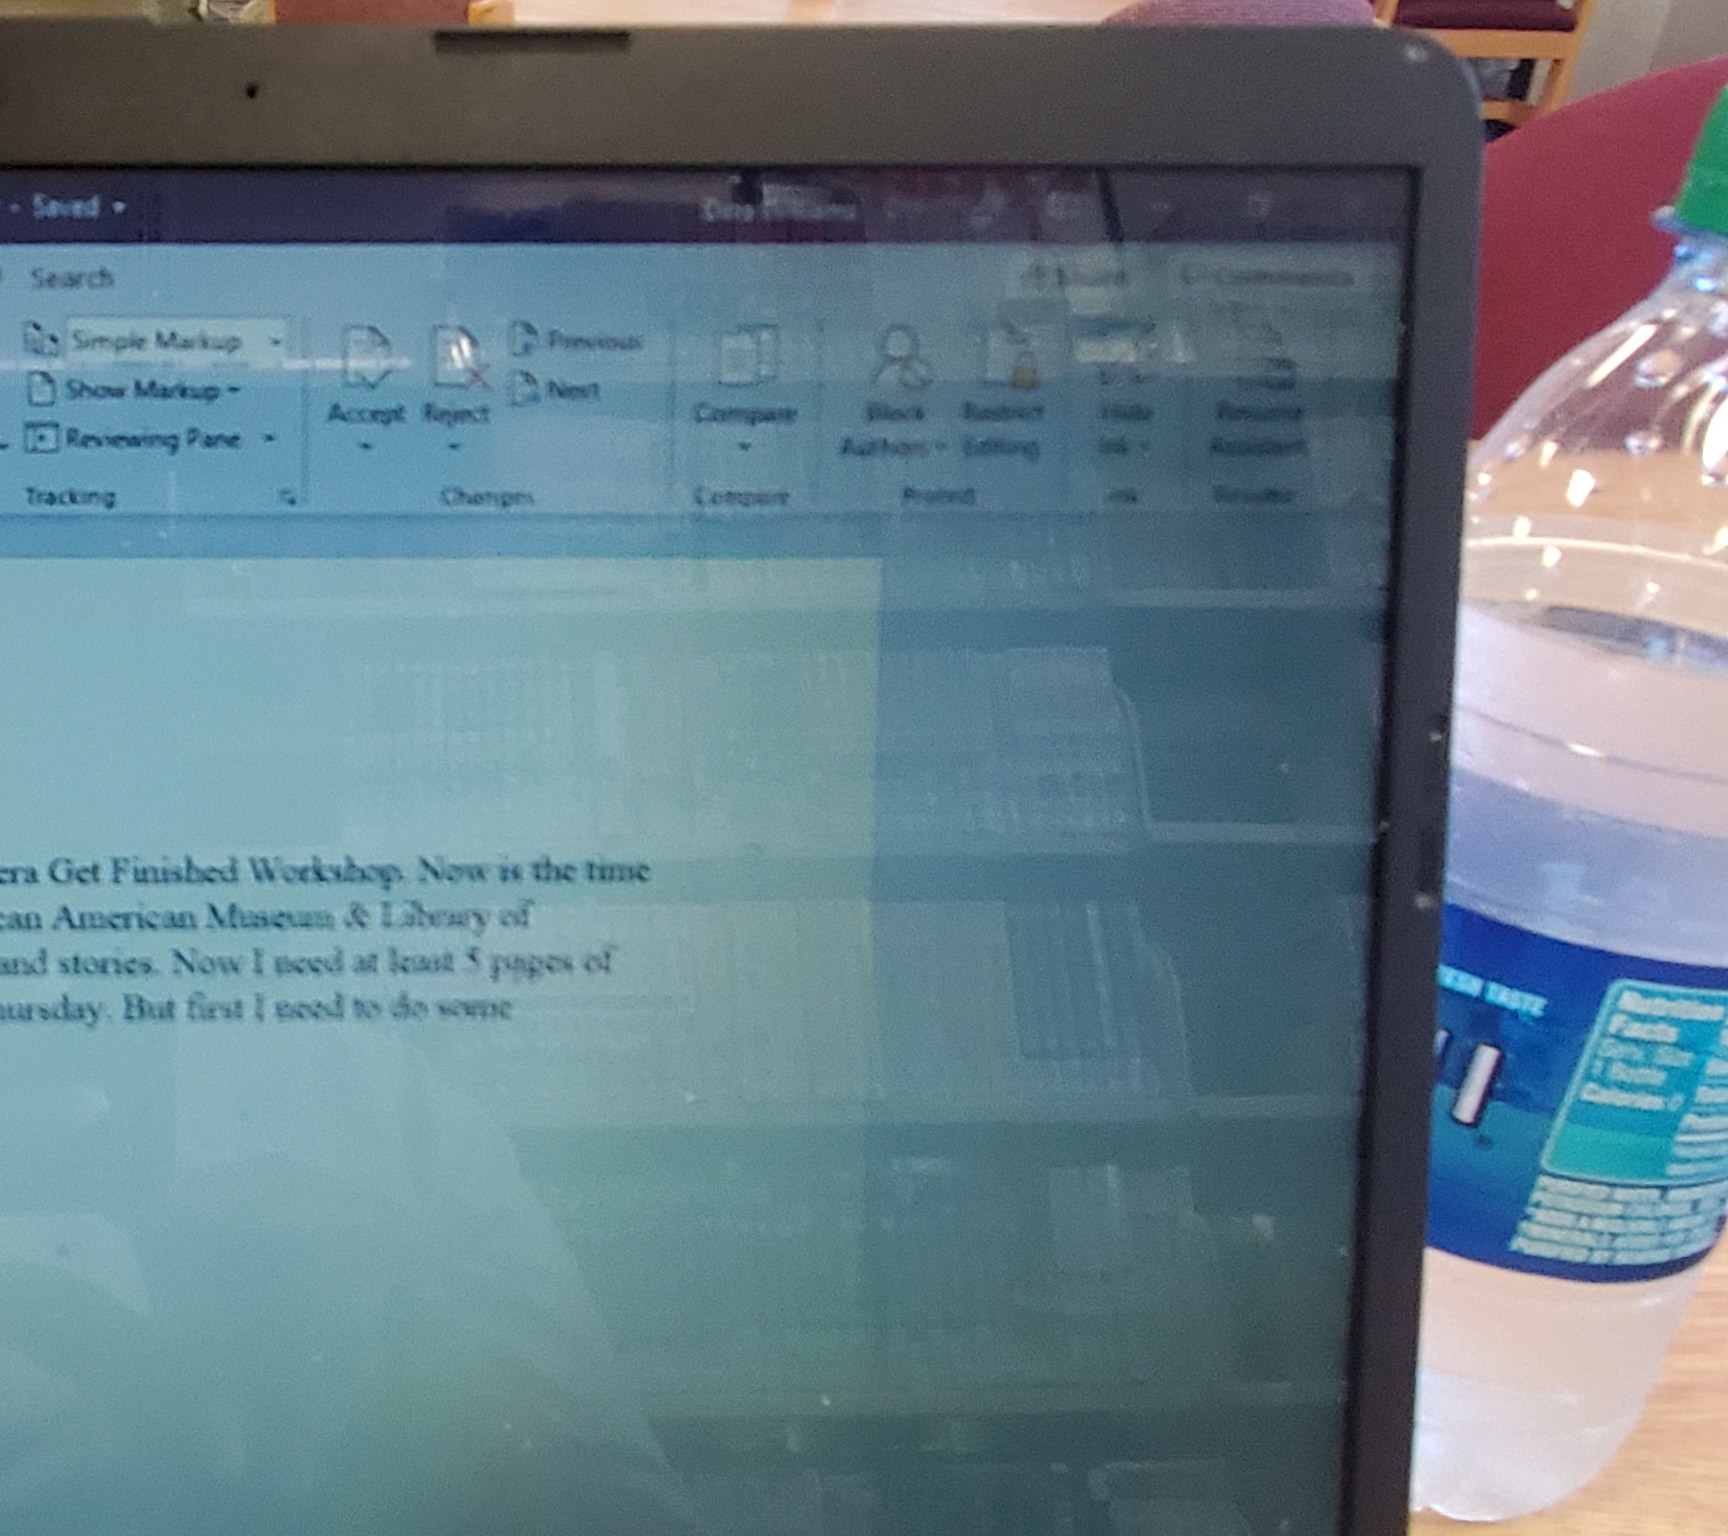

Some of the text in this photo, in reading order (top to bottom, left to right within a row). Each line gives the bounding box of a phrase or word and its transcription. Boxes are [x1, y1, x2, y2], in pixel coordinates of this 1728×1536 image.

[30, 265, 116, 290] Search
[73, 330, 243, 354] Simple Markup
[65, 380, 222, 403] Show Markup
[327, 401, 492, 428] Accept Reject
[65, 428, 242, 455] Reviewing Pane
[24, 486, 117, 511] Tracking
[48, 856, 101, 884] Get
[112, 855, 237, 883] Finished
[418, 854, 489, 882] Now
[499, 853, 522, 881] is
[532, 853, 578, 881] the
[586, 853, 651, 881] time
[52, 904, 197, 929] American
[205, 903, 334, 928] Museum
[343, 902, 370, 927] &
[380, 902, 492, 935] Library
[499, 901, 532, 926] of
[174, 949, 240, 975] Now
[253, 948, 265, 974] I
[275, 948, 344, 974] need
[352, 947, 379, 973] at
[388, 947, 454, 973] least
[463, 947, 480, 973] 5
[489, 954, 575, 980] pages
[582, 946, 614, 972] of
[122, 996, 175, 1021] But
[186, 995, 243, 1020] first
[253, 995, 265, 1020] I
[275, 994, 344, 1019] need
[352, 994, 381, 1019] to
[390, 993, 429, 1018] do
[437, 1000, 513, 1018] some
